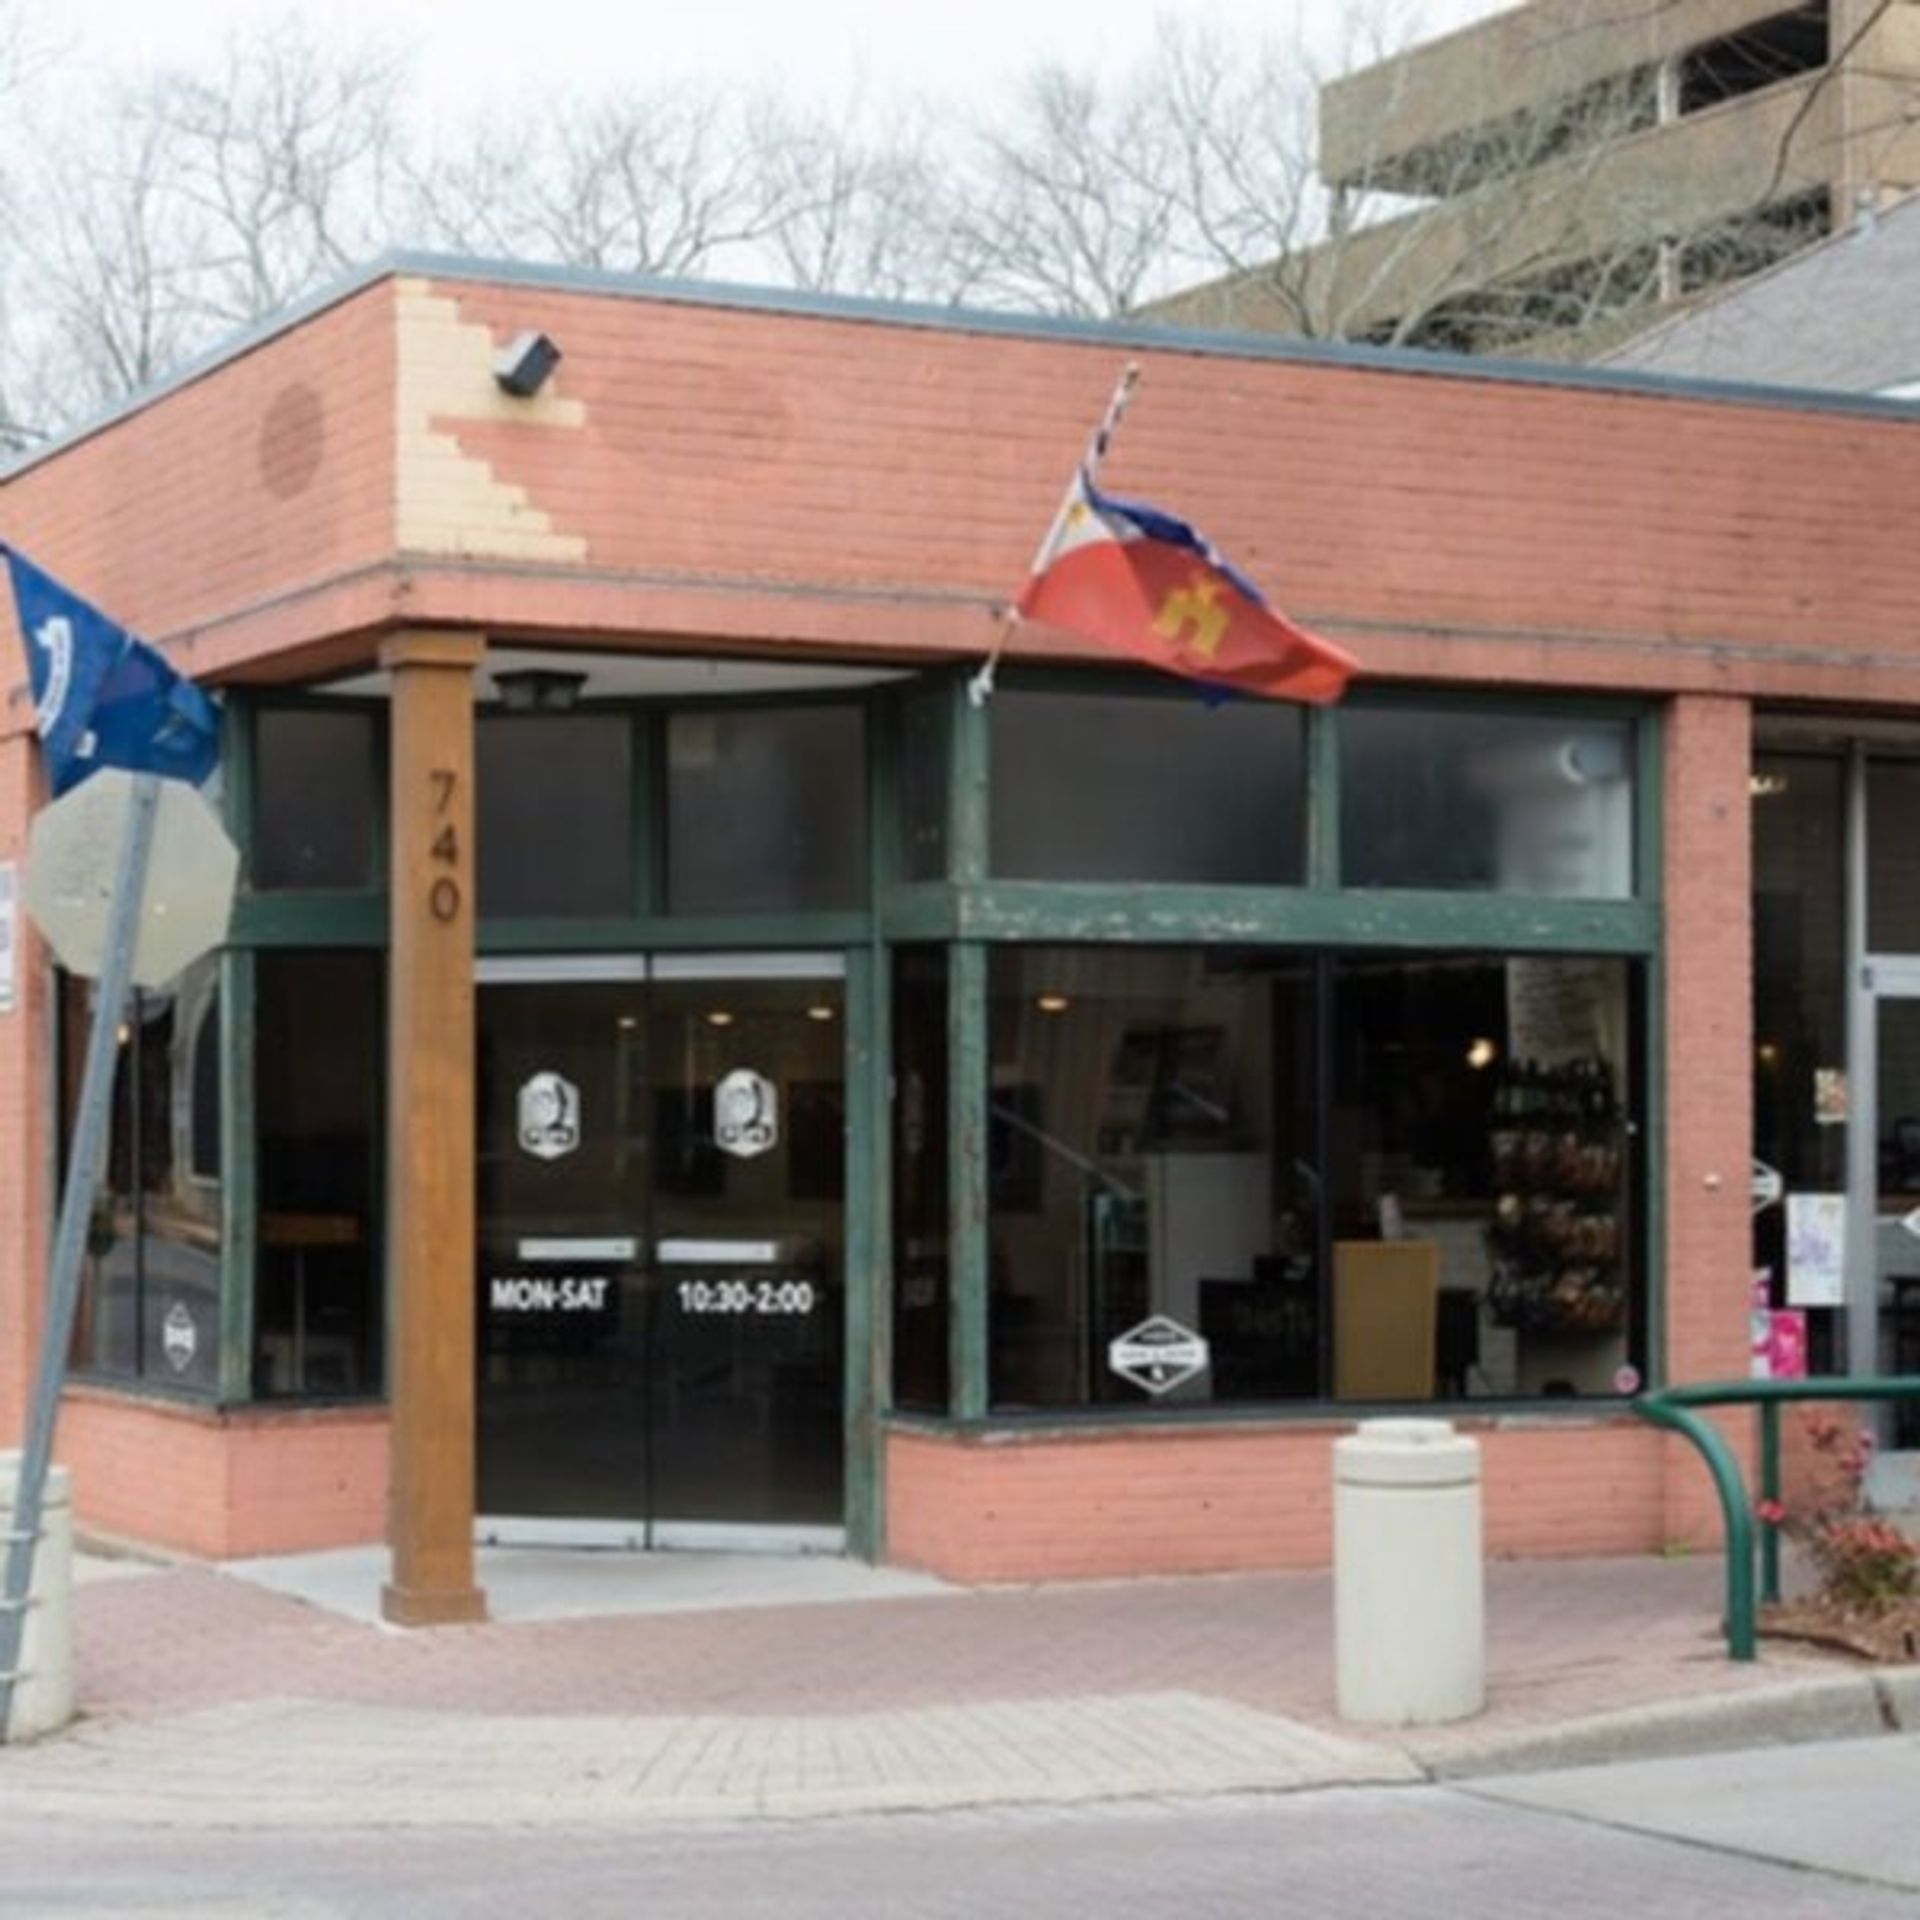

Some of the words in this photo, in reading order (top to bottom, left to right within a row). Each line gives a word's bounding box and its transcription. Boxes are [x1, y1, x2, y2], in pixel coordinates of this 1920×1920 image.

[429, 769, 461, 923] 740
[491, 1278, 608, 1311] MON-SAT
[679, 1281, 814, 1314] 10:30-2:00
